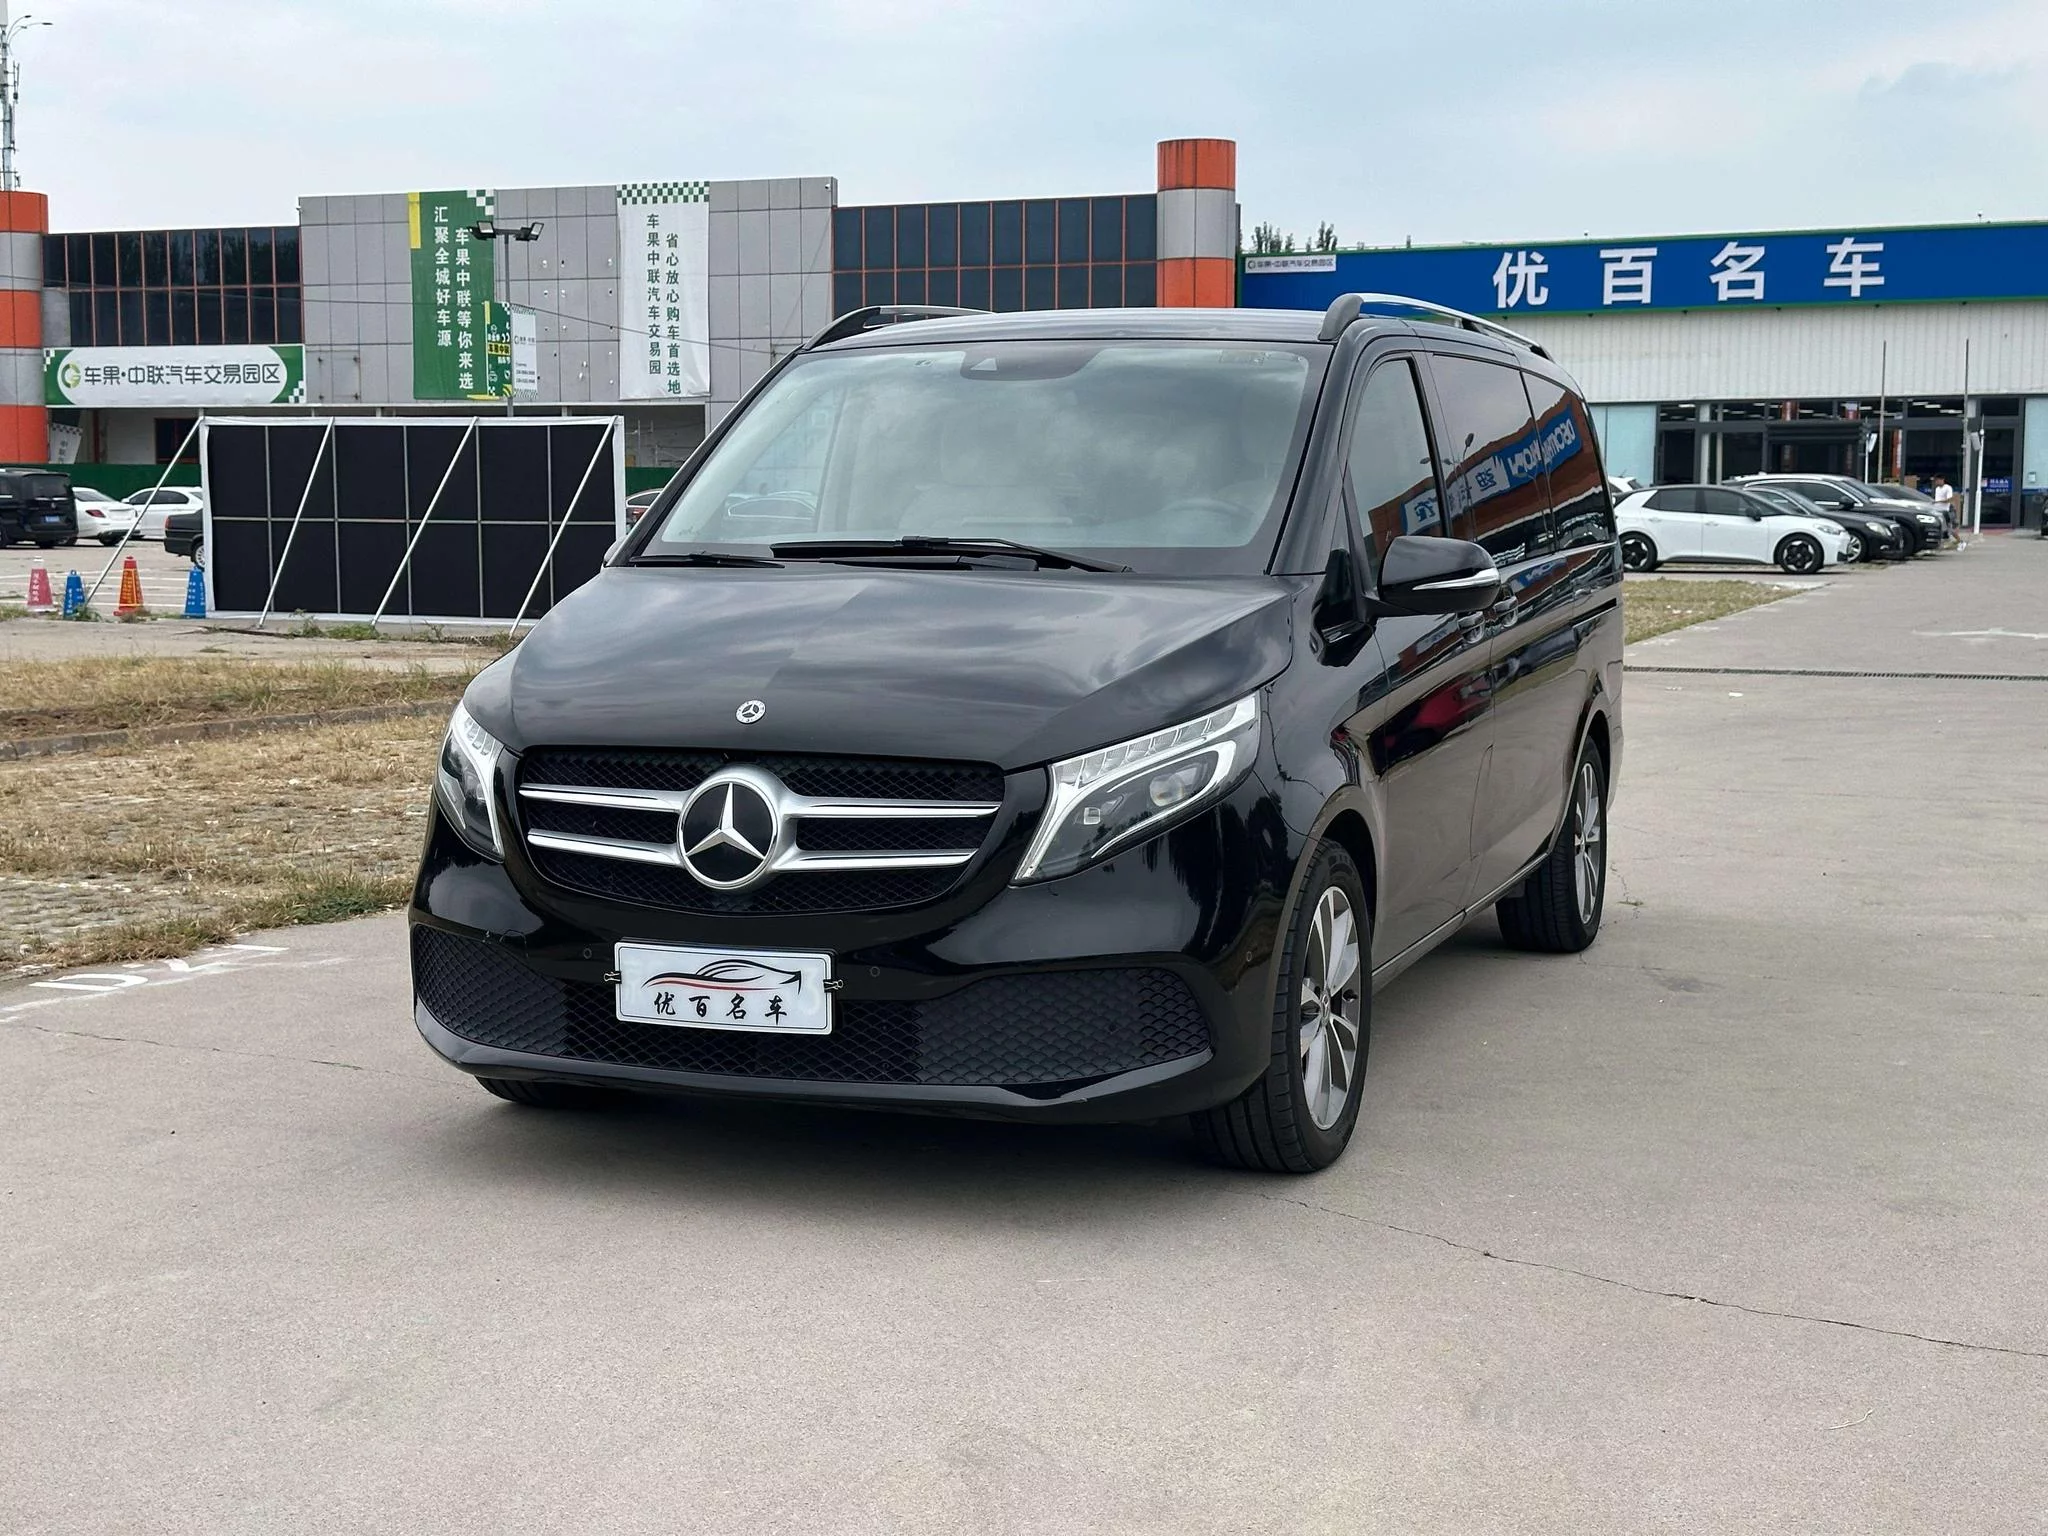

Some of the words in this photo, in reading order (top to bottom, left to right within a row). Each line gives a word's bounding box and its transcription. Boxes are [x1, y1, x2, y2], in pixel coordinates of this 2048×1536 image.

[434, 206, 452, 347] 汇聚全城好车源
[455, 227, 474, 390] 车果中联等你来选
[646, 213, 661, 375] 车果中联汽车交易园
[666, 232, 682, 395] 省心放心购车首选地
[1492, 237, 1885, 308] 优百名车
[653, 991, 788, 1026] 优百名车
